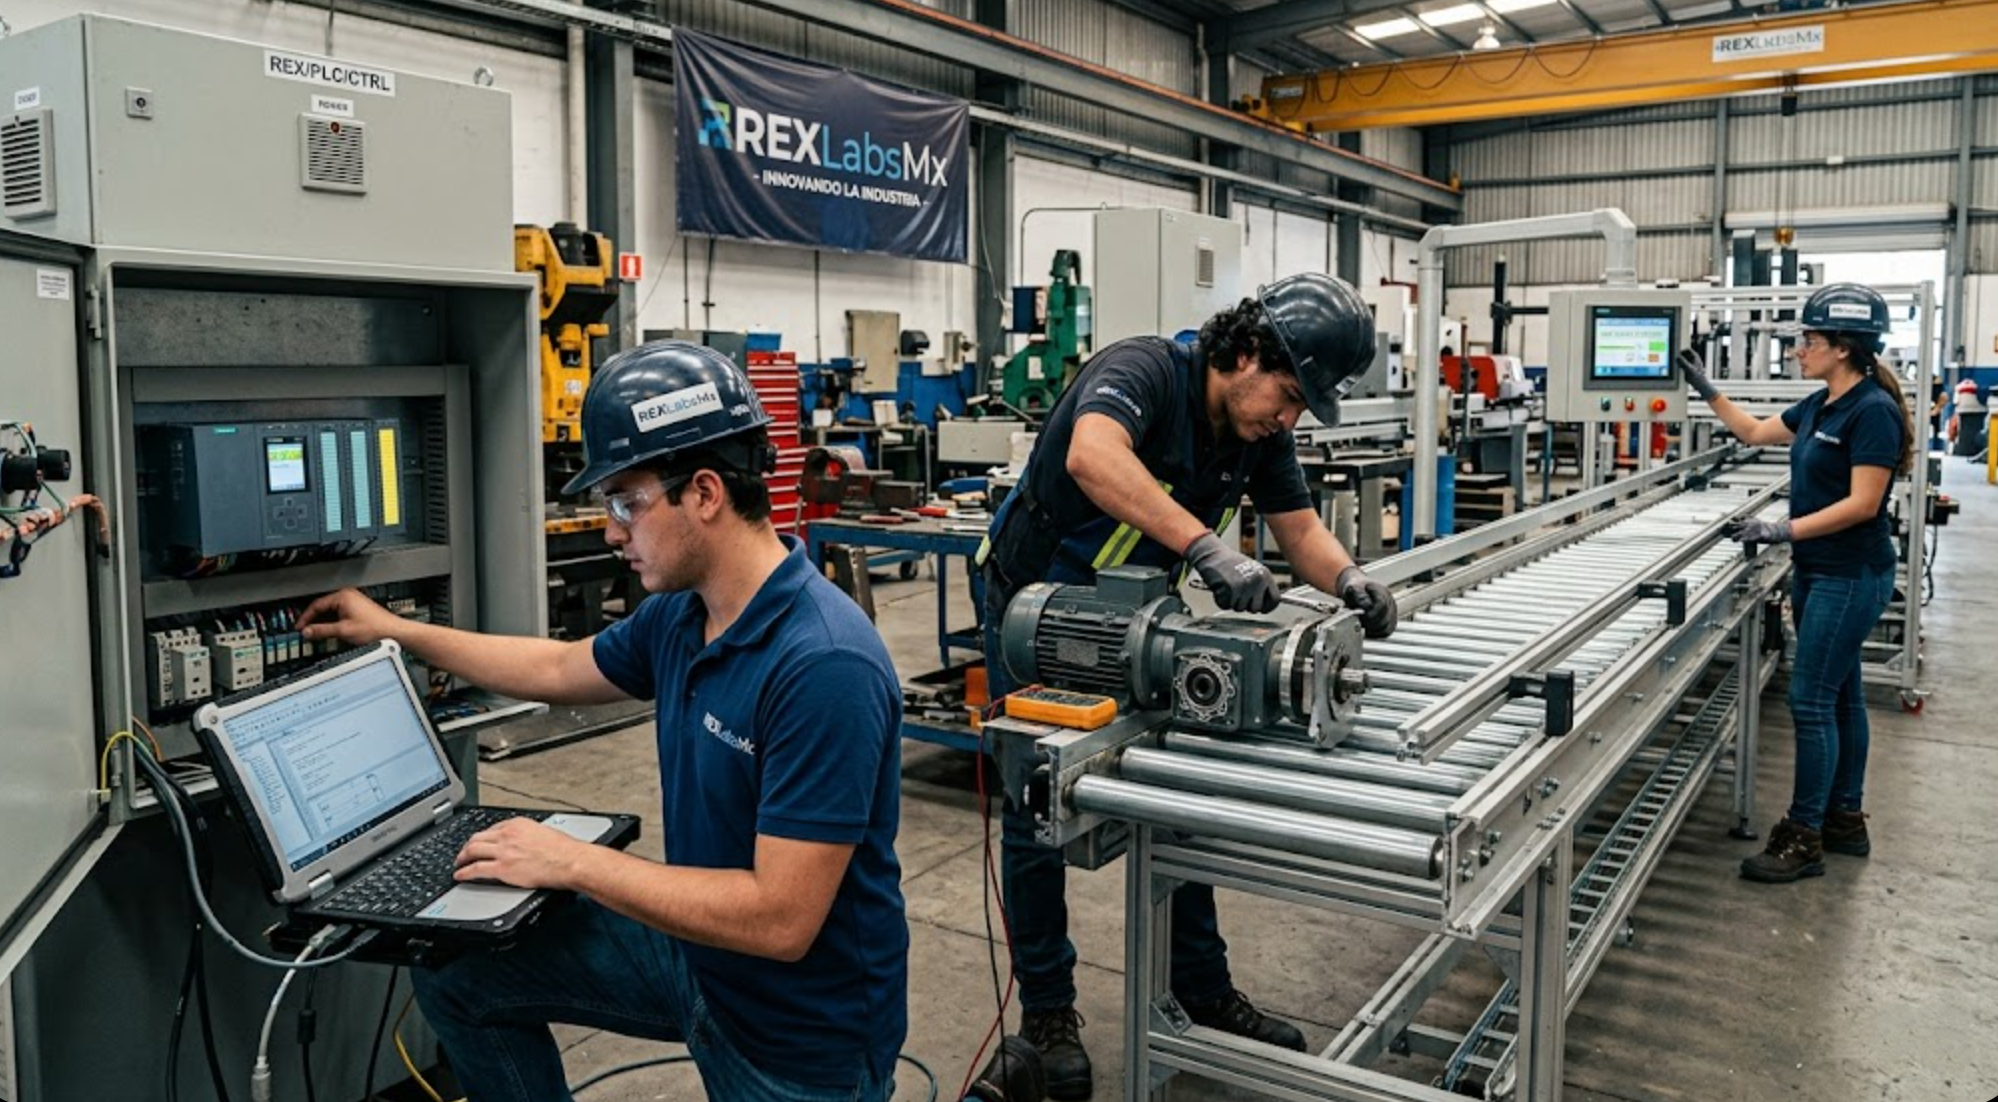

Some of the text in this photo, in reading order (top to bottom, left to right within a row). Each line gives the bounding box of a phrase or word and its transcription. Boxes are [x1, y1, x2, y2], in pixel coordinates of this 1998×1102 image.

[270, 56, 391, 91] REX/PLC/CTRL
[736, 106, 947, 187] REXLabsMx
[763, 170, 841, 194] INNOVANDO
[843, 182, 860, 199] LA
[861, 185, 921, 208] INDUSTRIA
